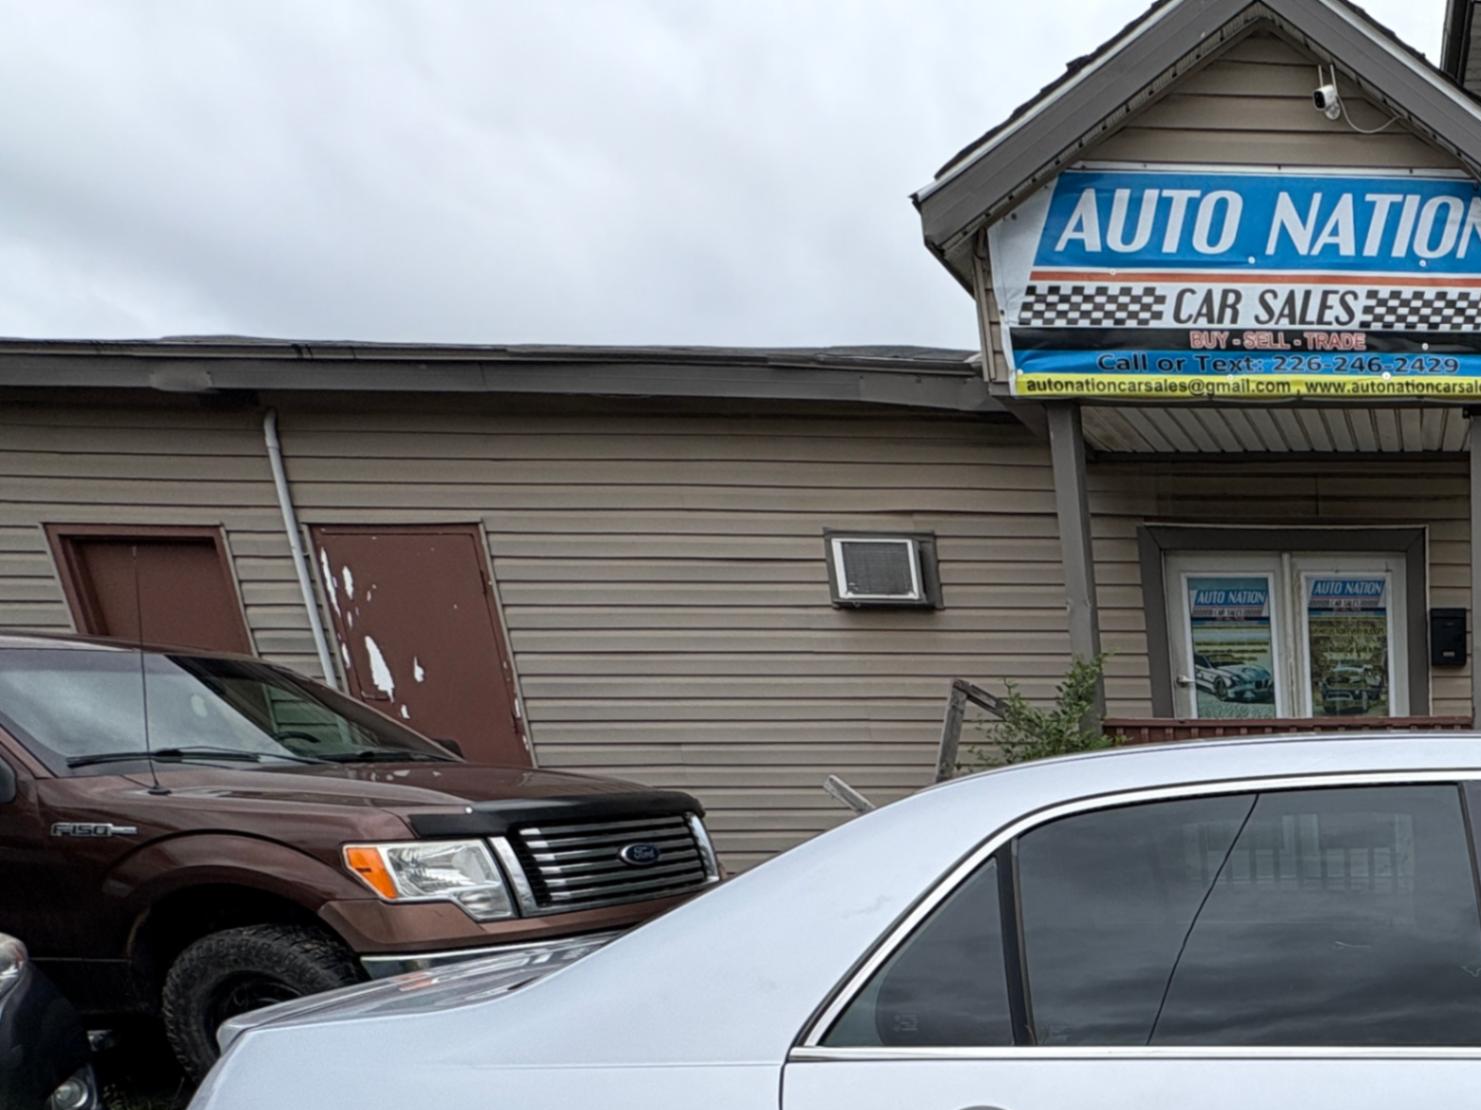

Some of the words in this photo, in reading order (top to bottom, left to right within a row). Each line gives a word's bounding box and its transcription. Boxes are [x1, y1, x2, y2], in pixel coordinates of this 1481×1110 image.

[1055, 188, 1243, 254] AUTO
[1173, 288, 1242, 325] CAR
[1254, 289, 1359, 326] SALES
[1189, 330, 1229, 349] BUY
[1243, 331, 1291, 350] SELL
[1304, 332, 1367, 350] TRADE
[1098, 353, 1148, 372] Call
[1157, 356, 1184, 373] or
[1198, 354, 1264, 373] Text:
[1272, 355, 1460, 375] 226-246-2429
[1027, 378, 1291, 396] autonationcarsales@gmail.com
[1197, 591, 1225, 604] AUTO
[1228, 591, 1266, 604] NATION
[1314, 581, 1342, 593] AUTO
[1344, 581, 1382, 594] NATION
